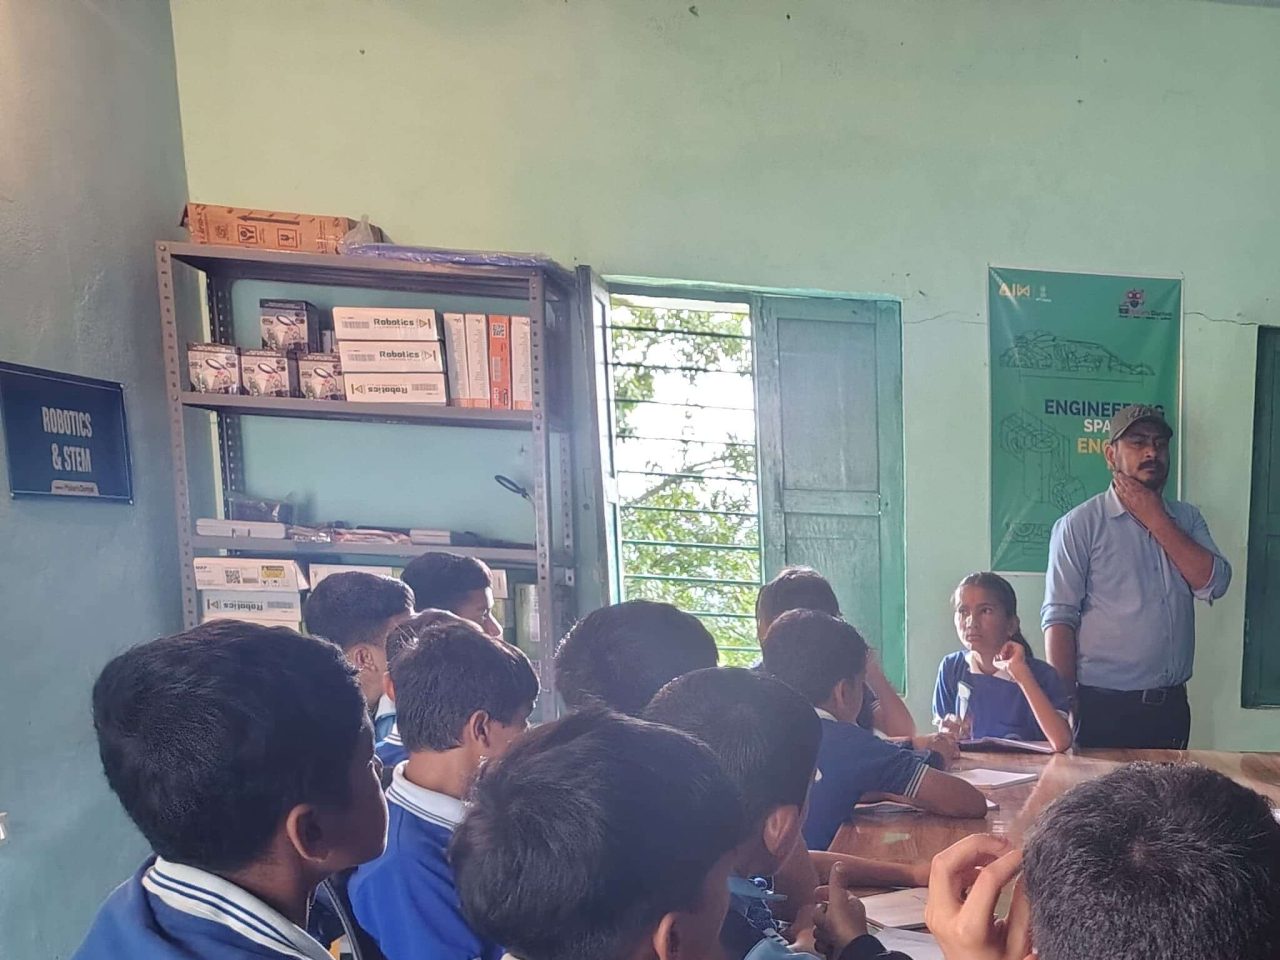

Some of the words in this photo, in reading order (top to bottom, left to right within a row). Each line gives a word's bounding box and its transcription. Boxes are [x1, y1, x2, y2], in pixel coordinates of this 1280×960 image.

[373, 317, 414, 327] Robotics
[379, 350, 420, 359] Robotics
[367, 385, 408, 394] Robotics
[1044, 399, 1165, 418] ENGINEE
[41, 406, 93, 438] ROBOTICS
[1083, 418, 1111, 433] SPA
[51, 442, 63, 471] &
[63, 446, 92, 472] STEM
[223, 602, 264, 612] Robotics
